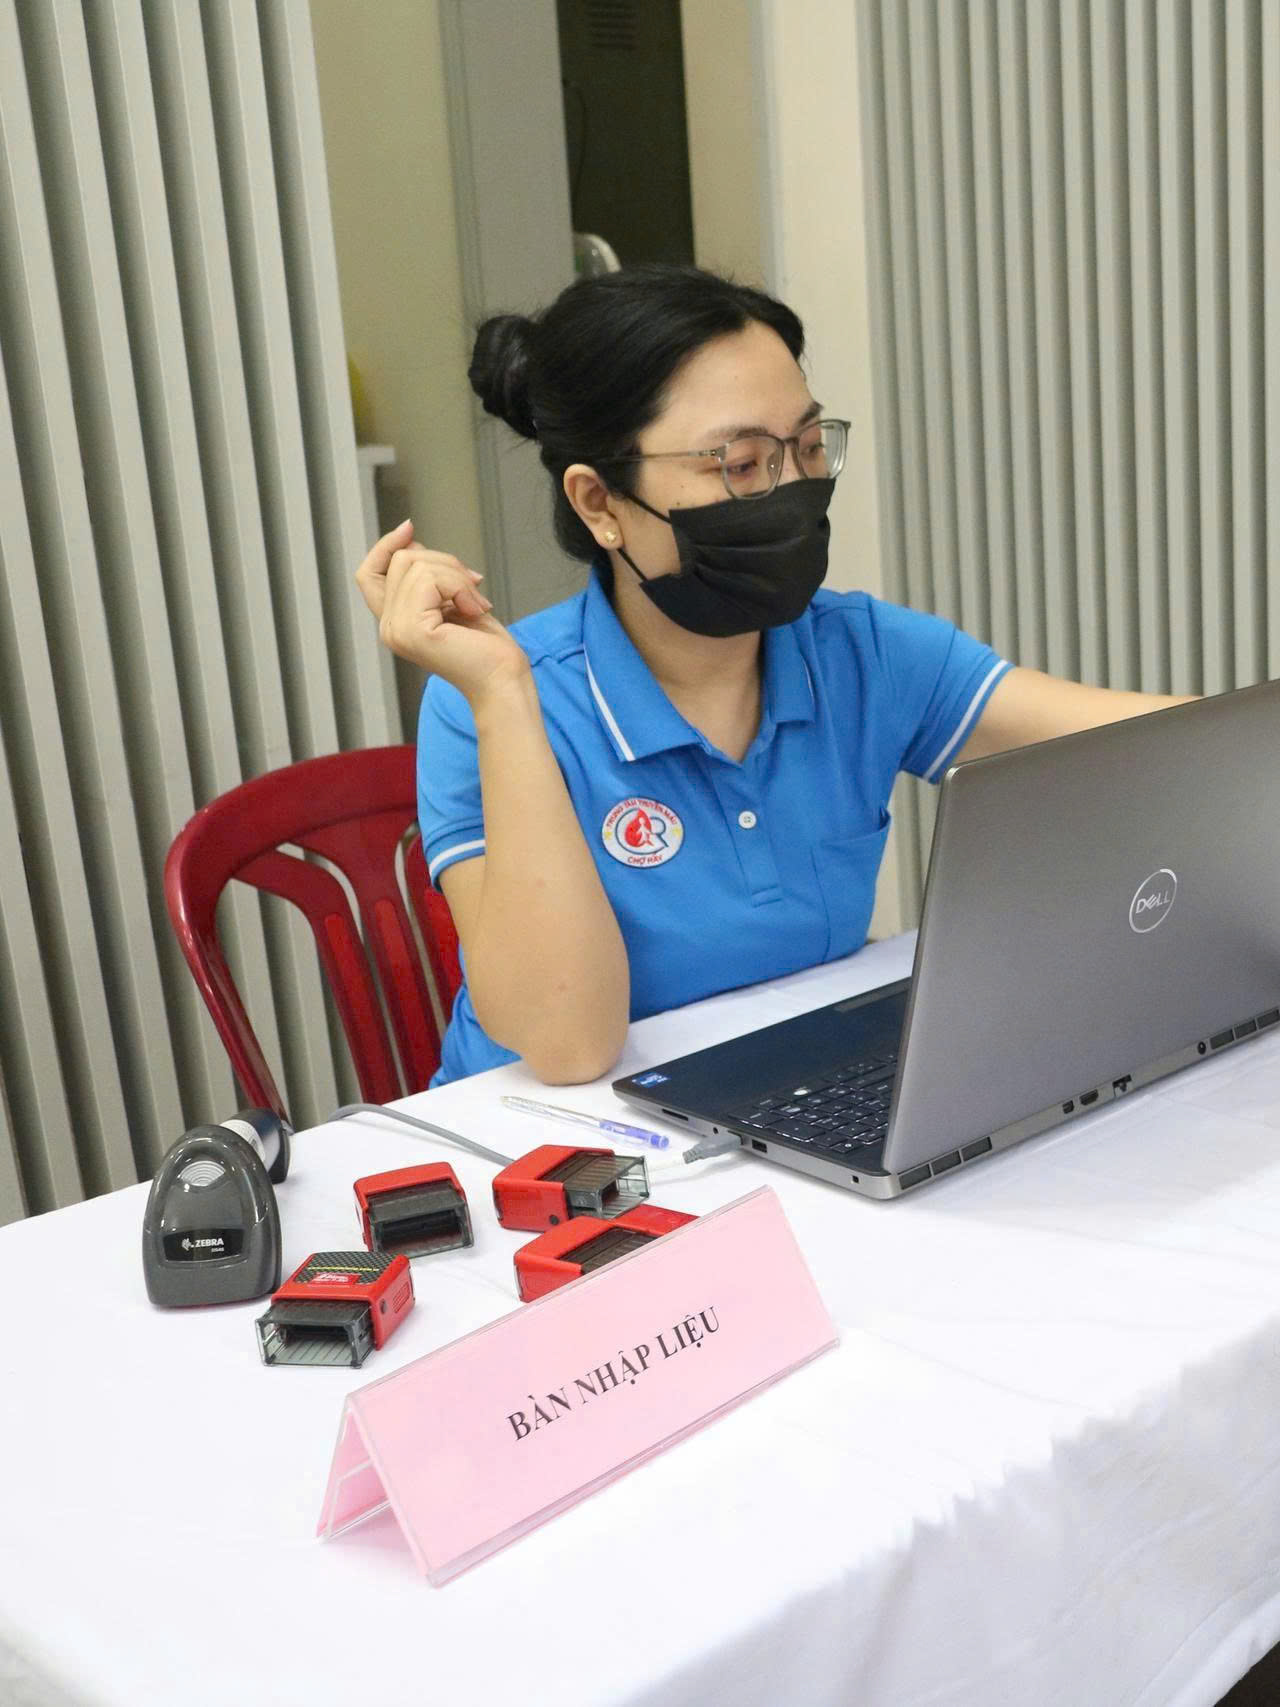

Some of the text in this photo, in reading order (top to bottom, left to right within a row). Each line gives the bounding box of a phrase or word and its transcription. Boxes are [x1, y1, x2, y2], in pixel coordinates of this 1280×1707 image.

[1135, 890, 1170, 914] DELL
[194, 1238, 225, 1248] ZEBRA
[506, 1306, 720, 1441] BÀN NHẬP LIỆU
